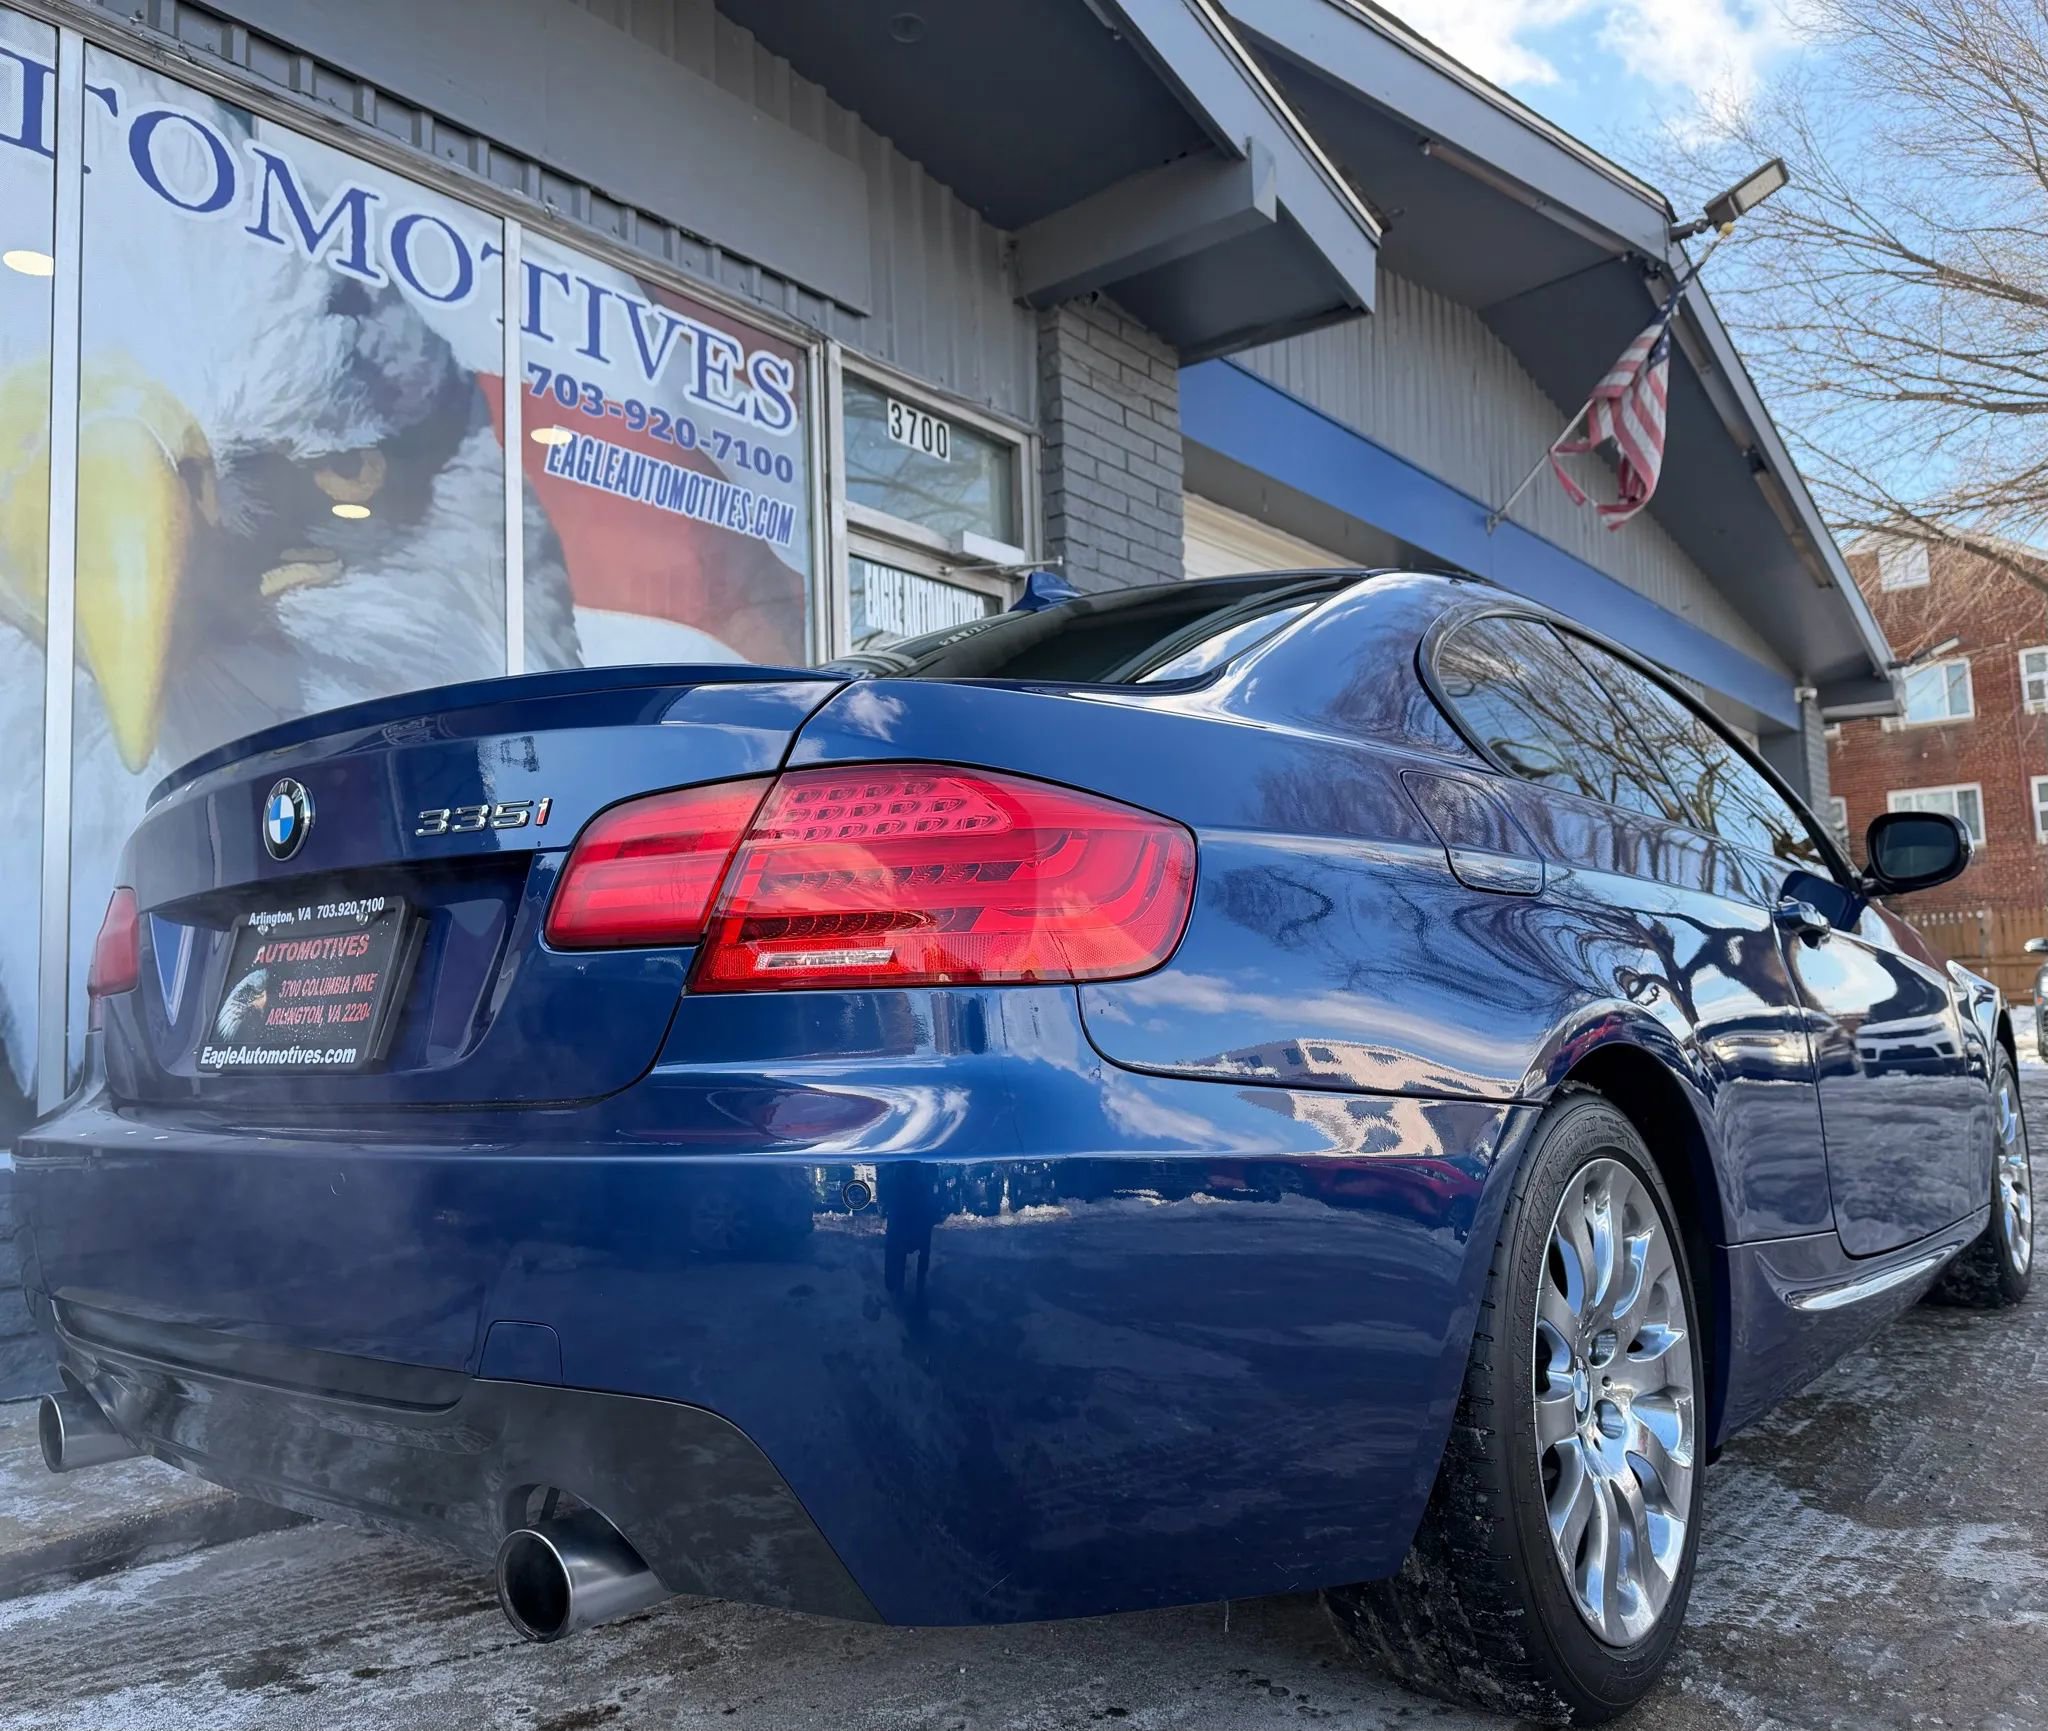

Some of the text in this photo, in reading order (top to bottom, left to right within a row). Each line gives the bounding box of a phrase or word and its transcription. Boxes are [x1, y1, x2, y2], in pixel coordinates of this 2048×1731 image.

[528, 362, 793, 483] 703-920-7100
[891, 403, 948, 459] 3700
[547, 429, 794, 544] EAGLEAUTOMOTIVES.COM
[415, 797, 553, 837] 335i
[248, 897, 384, 927] Arlington, VA 703.920.7100
[253, 934, 370, 964] AUTOMOTIVES
[278, 972, 378, 998] 3700 COLUMBIA PIKE
[265, 1006, 324, 1026] ARLINGTON,
[327, 1004, 342, 1023] VA
[201, 1046, 357, 1069] EagleAutomotives.com
